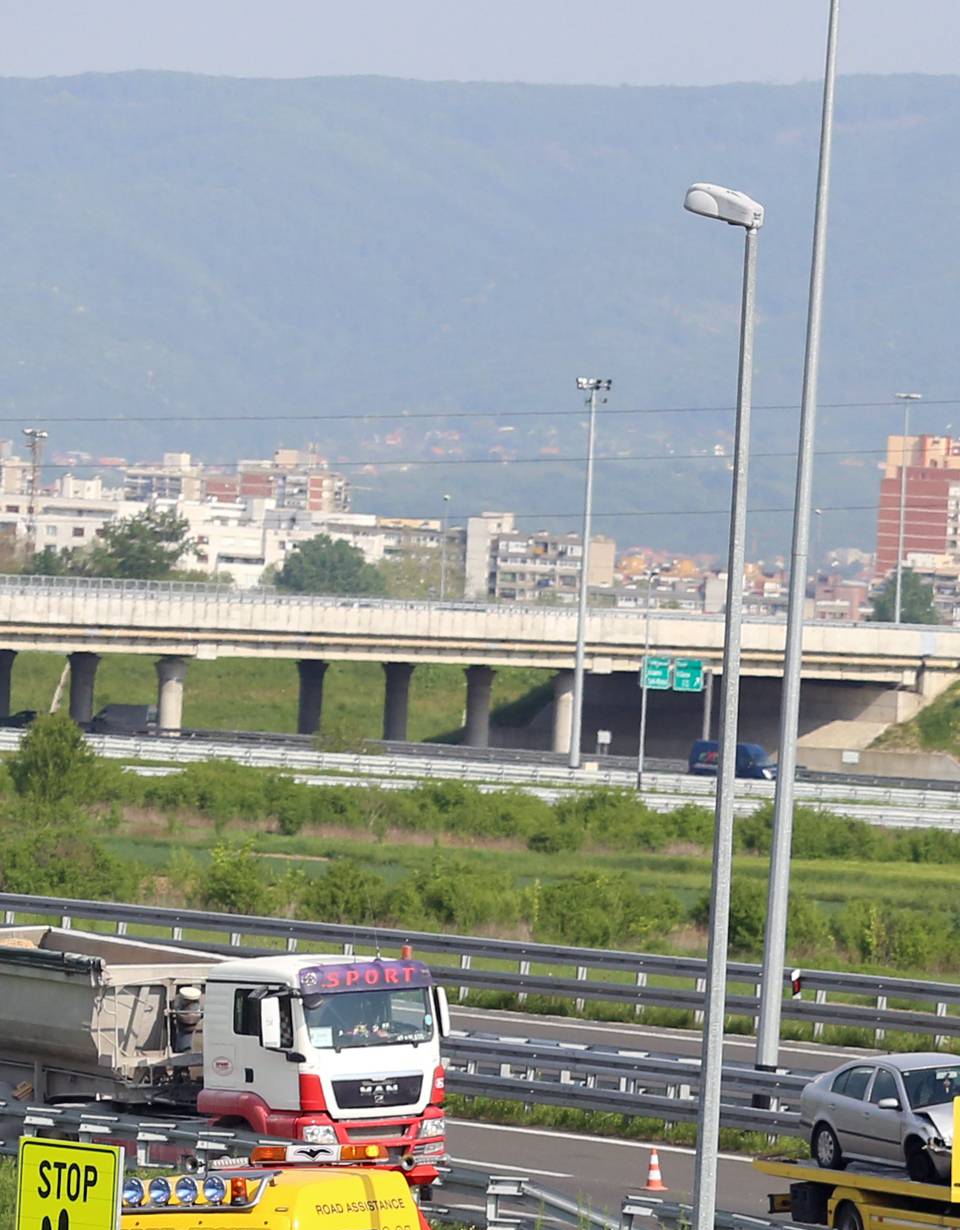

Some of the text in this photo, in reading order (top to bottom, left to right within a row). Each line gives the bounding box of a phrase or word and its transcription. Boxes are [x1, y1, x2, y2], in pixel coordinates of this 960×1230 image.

[322, 968, 415, 988] SPORT
[359, 1084, 398, 1093] MAN
[37, 1159, 98, 1203] STOP
[315, 1198, 406, 1215] ROAD ASSISTANCE
